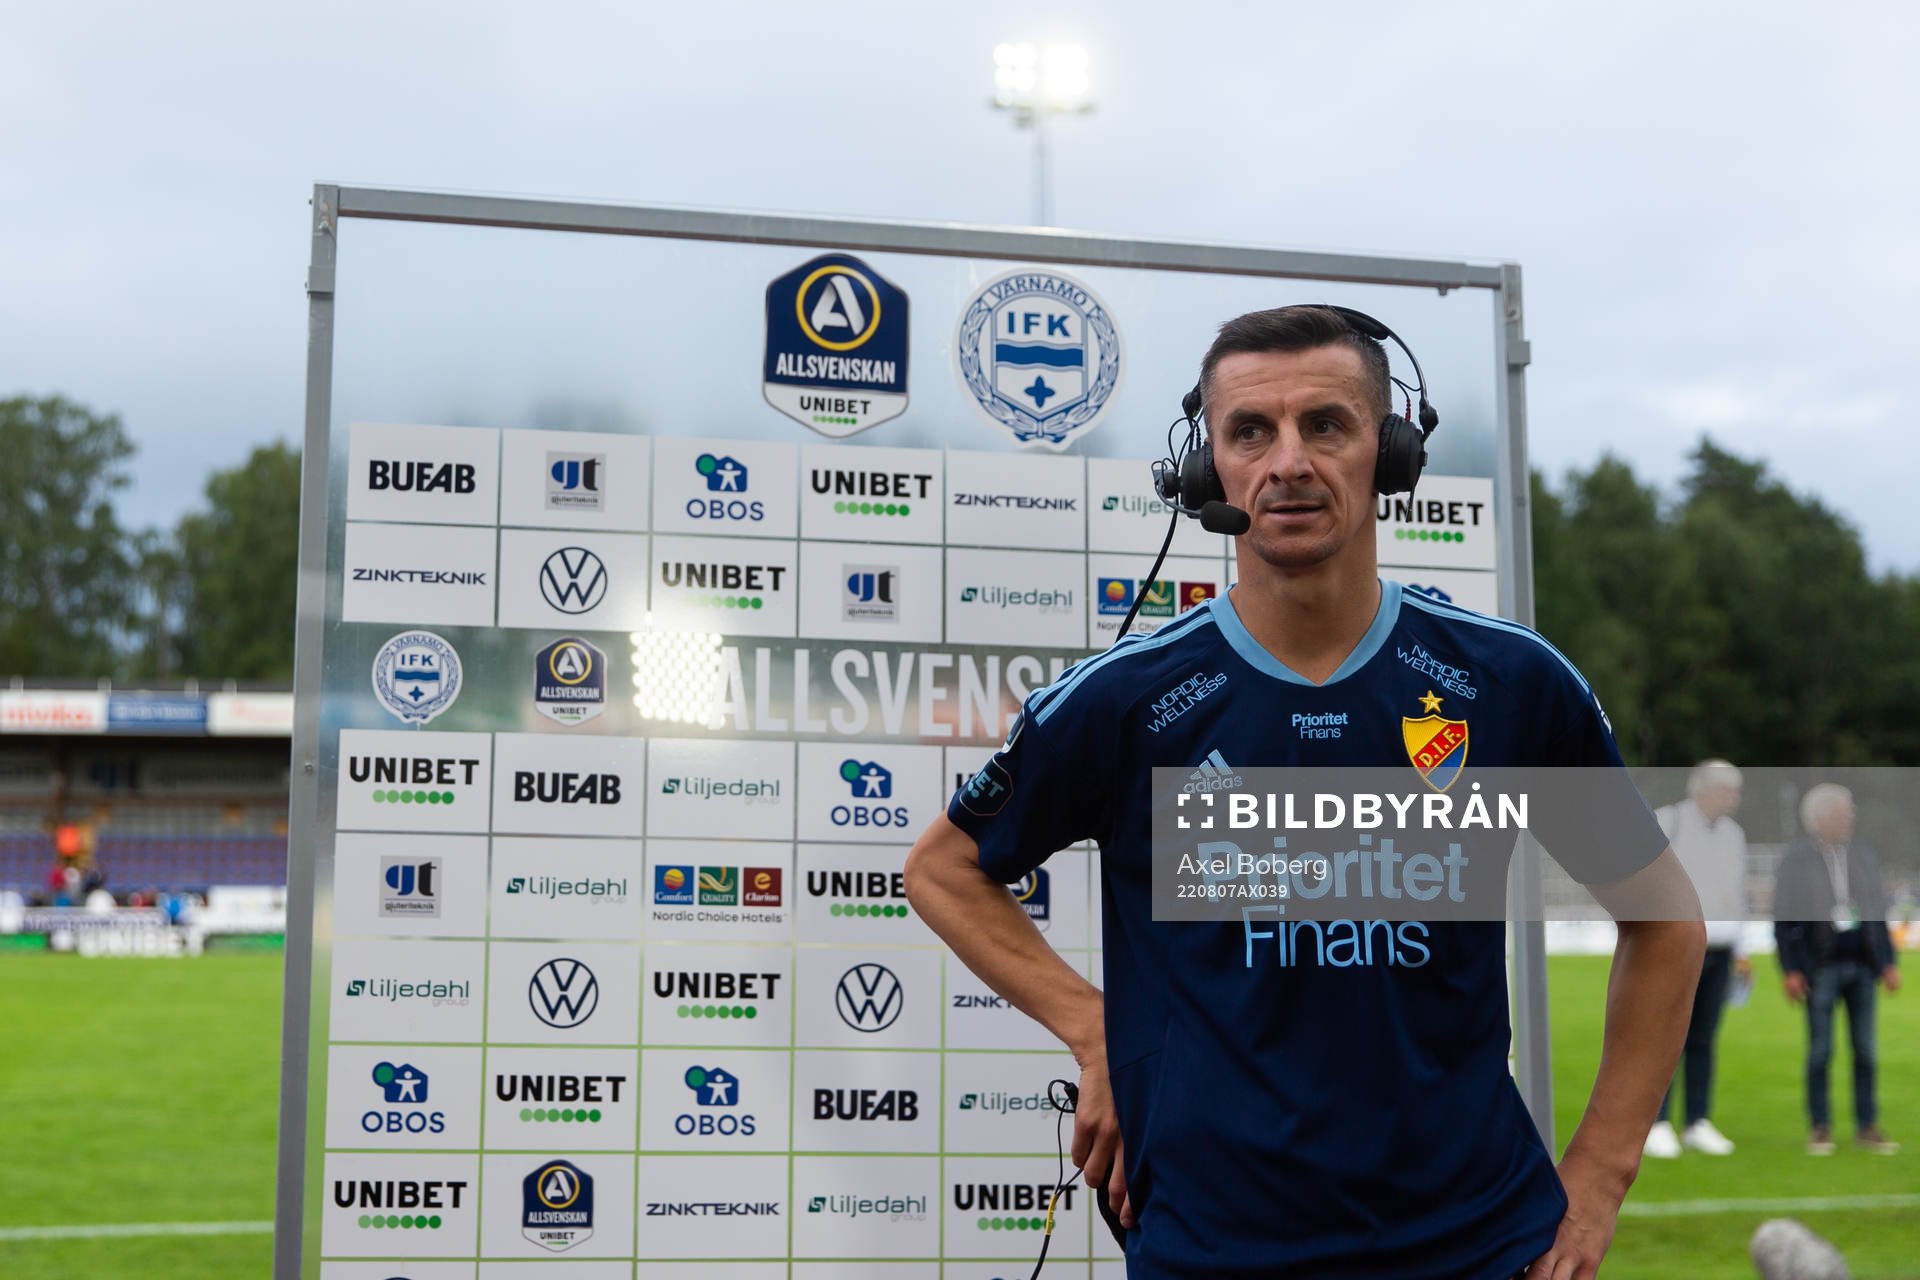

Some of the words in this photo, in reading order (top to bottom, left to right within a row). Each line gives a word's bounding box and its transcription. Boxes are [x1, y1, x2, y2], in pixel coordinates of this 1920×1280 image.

[1008, 311, 1071, 337] IFK
[776, 353, 896, 384] ALLSVENSKAN
[800, 396, 871, 414] UNIBET
[368, 459, 476, 494] BUFAB
[811, 469, 932, 499] UNIBET
[686, 499, 765, 521] OBOS
[953, 493, 1077, 511] ZINKTEKNIK
[352, 568, 487, 586] ZINKTEKNIK
[662, 562, 787, 591] UNIBET
[981, 586, 1073, 609] Liljedahl
[401, 654, 433, 666] IFK
[1411, 644, 1470, 684] NORDIC
[1397, 647, 1478, 700] WELLNESS
[540, 686, 600, 700] ALLSVENSKAN
[1147, 672, 1228, 734] WELLNESS
[1151, 672, 1207, 715] NORDIC
[552, 706, 587, 715] UNIBET
[1292, 712, 1348, 727] Prioritet
[1300, 727, 1341, 739] Finans
[1418, 728, 1462, 768] D.I.F.
[349, 757, 479, 785] UNIBET
[514, 771, 622, 804] BUFAB
[684, 777, 780, 801] Liljedahl
[1183, 773, 1244, 794] adidas
[831, 806, 909, 827] OBOS
[1197, 834, 1470, 903] Prioritet
[529, 877, 627, 901] Liljedahl
[808, 871, 907, 898] UNIBE
[653, 911, 694, 921] Nordic
[697, 911, 739, 922] Choice
[742, 913, 784, 923] Hotels
[1241, 904, 1431, 968] Finans
[369, 979, 470, 1002] Liljedahl
[653, 972, 781, 999] UNIBET
[496, 1075, 626, 1102] UNIBET
[813, 1089, 919, 1121] BUFAB
[361, 1111, 446, 1134] OBOS
[674, 1115, 757, 1136] OBOS
[334, 1181, 467, 1208] UNIBET
[953, 1184, 1078, 1211] UNIBET
[527, 1211, 588, 1224] ALLSVENSKAN
[646, 1203, 780, 1216] ZINKTEKNIK
[830, 1196, 927, 1218] Liljedahl
[540, 1231, 575, 1240] UNIBET
